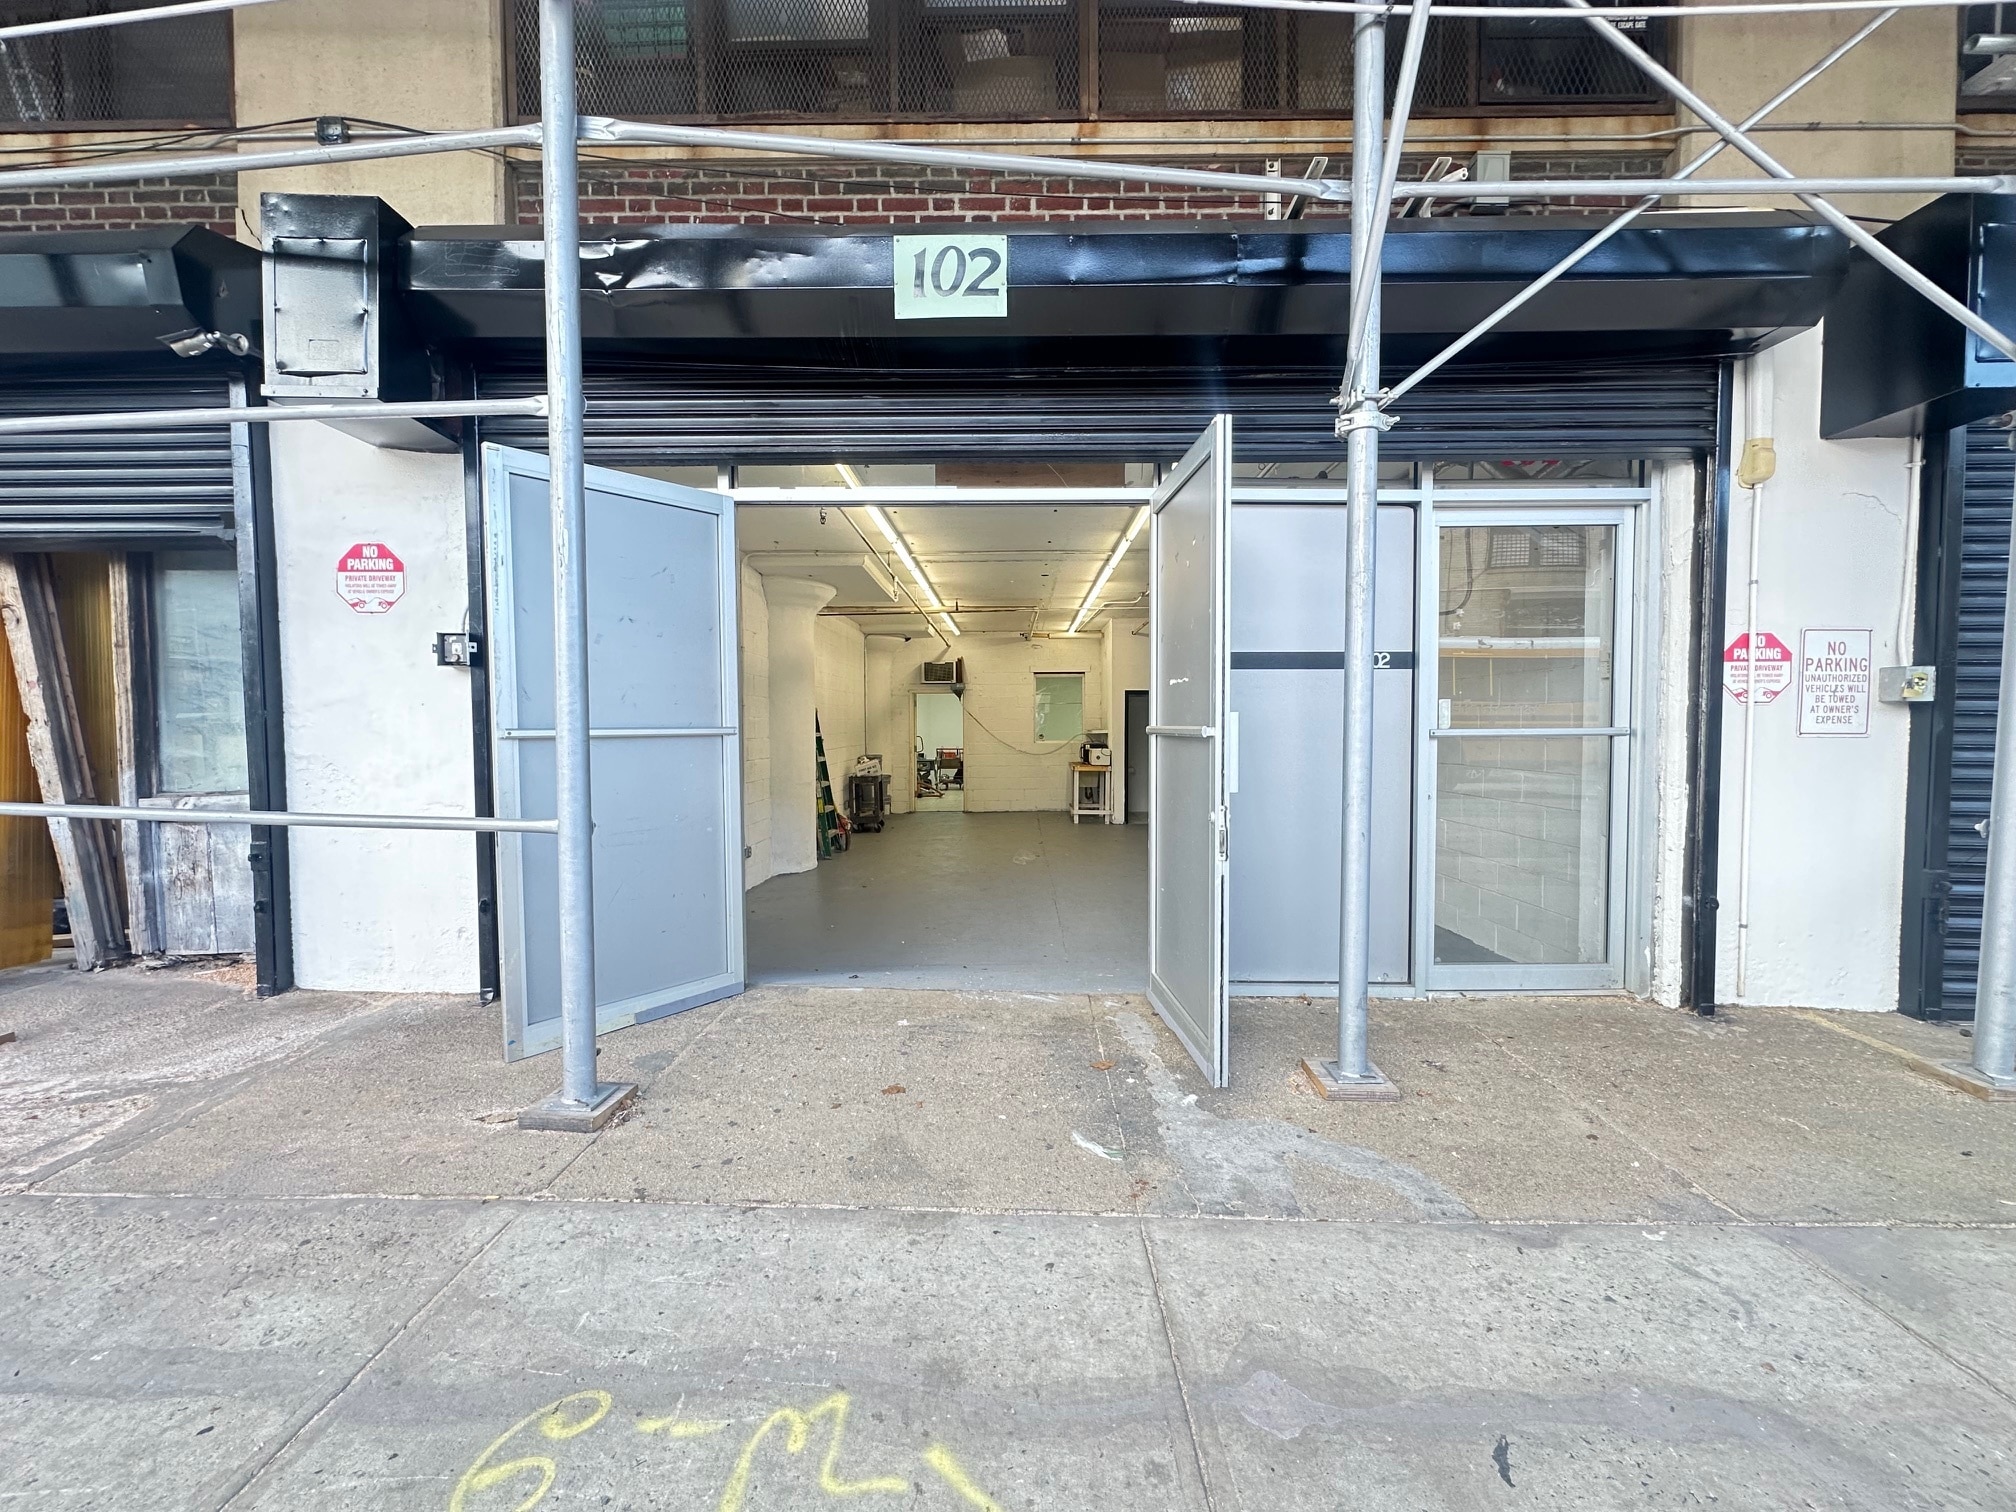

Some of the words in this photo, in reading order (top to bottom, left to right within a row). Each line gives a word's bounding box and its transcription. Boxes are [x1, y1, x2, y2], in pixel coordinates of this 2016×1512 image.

[913, 245, 1001, 298] 102
[362, 545, 378, 558] NO
[347, 558, 394, 570] PARKING
[1733, 647, 1782, 660] PAKING
[1827, 641, 1847, 656] NO
[1373, 652, 1391, 669] 02
[1805, 657, 1868, 672] PARKING
[1804, 673, 1867, 683] UNAUTHORIZED
[1805, 684, 1845, 693] VEHICLES
[1847, 684, 1866, 693] WILL
[1815, 694, 1826, 704] BE
[1829, 694, 1856, 704] TOWED
[1810, 705, 1820, 714] AT
[1823, 705, 1859, 714] OWNER'S
[1815, 715, 1853, 724] EXPENSE
